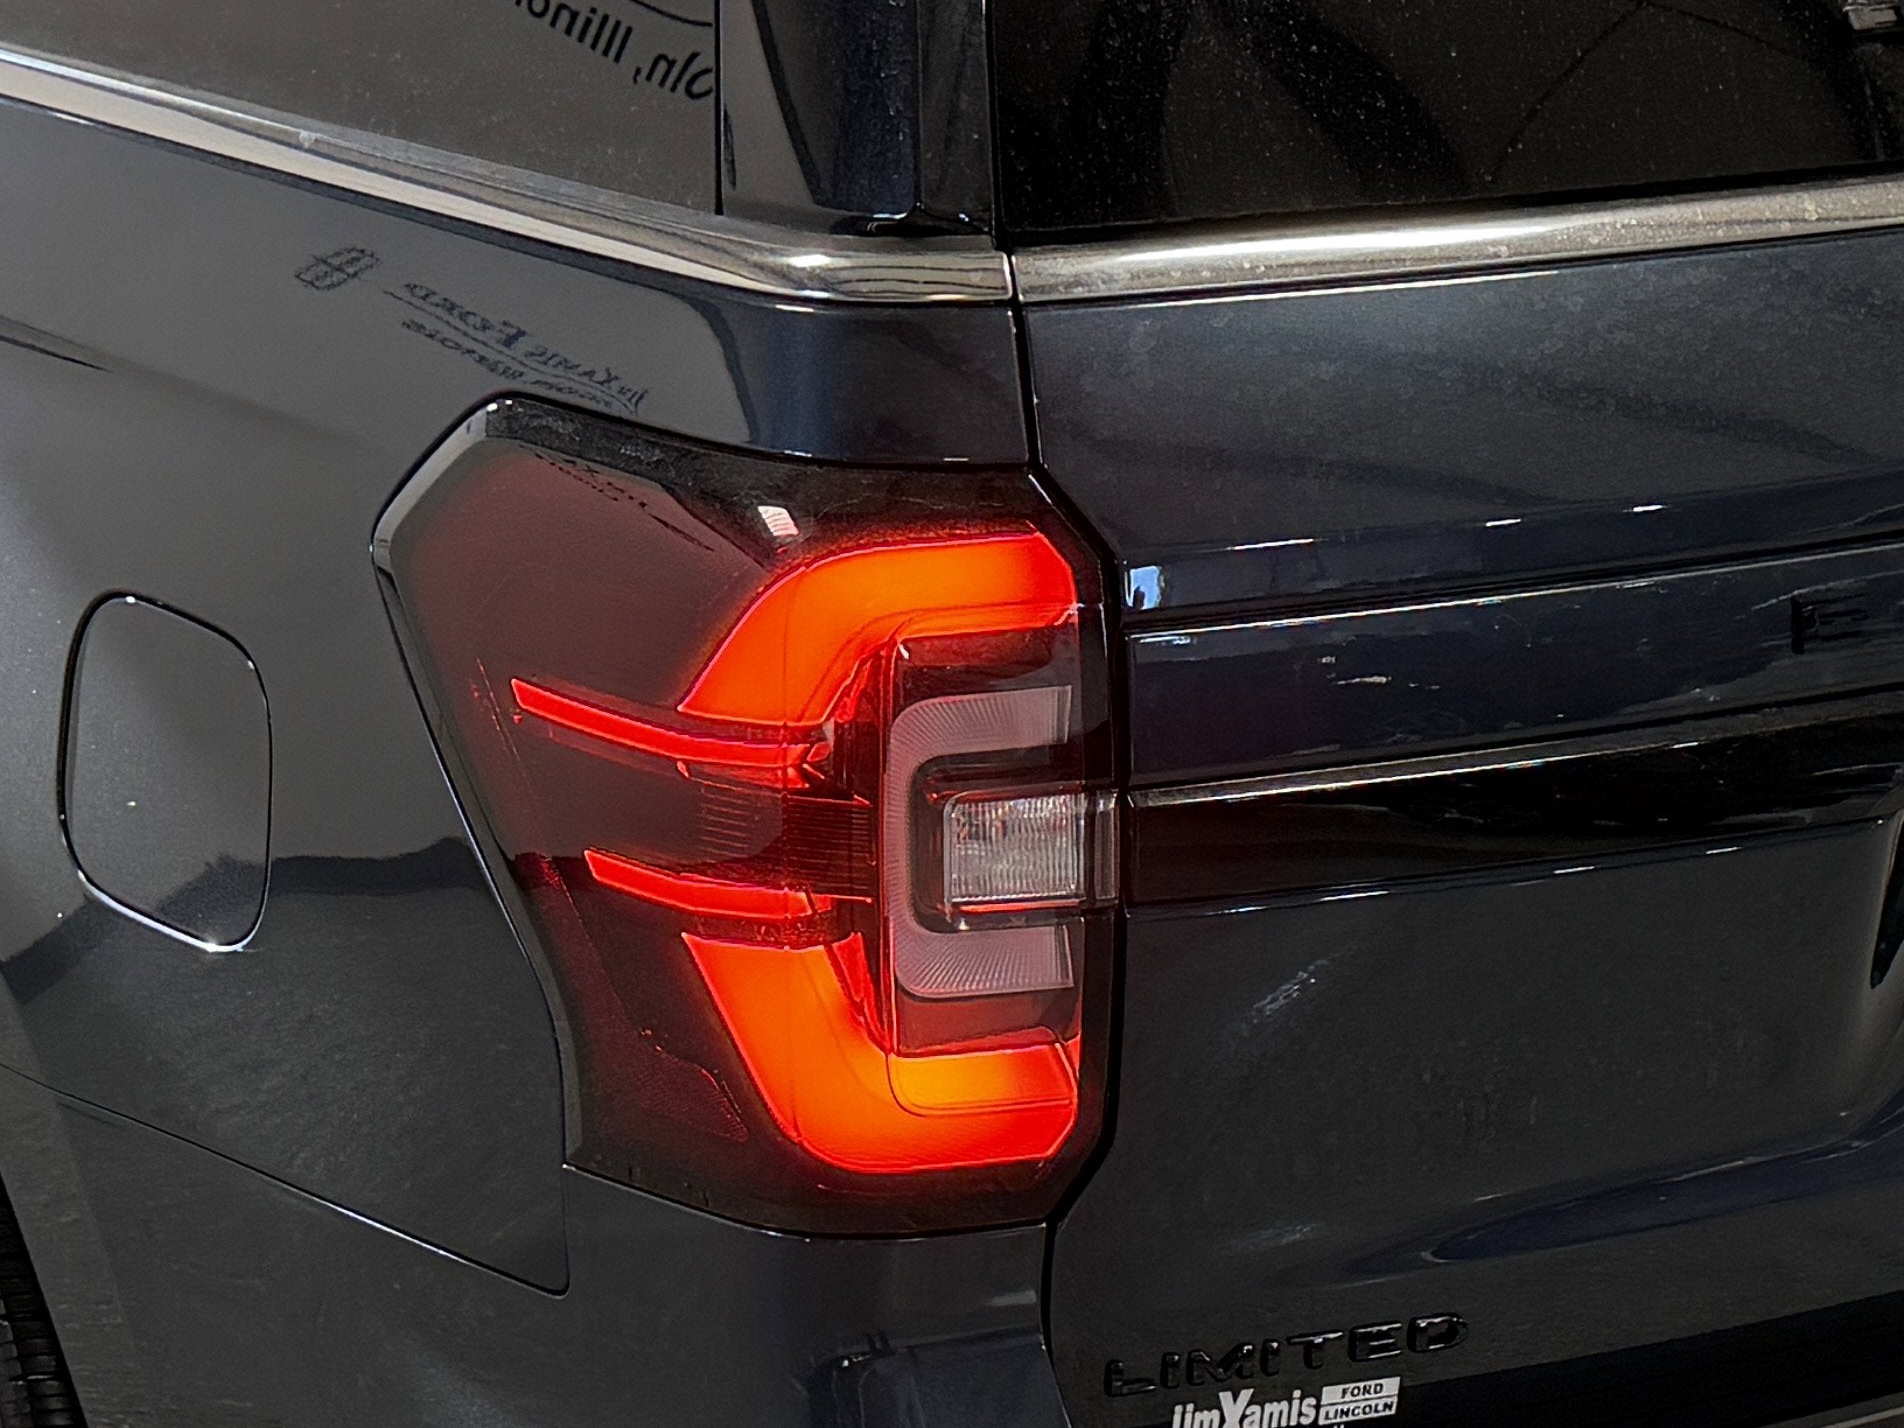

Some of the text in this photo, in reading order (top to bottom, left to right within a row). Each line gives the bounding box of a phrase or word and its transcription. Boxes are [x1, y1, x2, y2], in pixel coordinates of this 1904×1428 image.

[1102, 1311, 1470, 1399] LIMITED
[1340, 1382, 1385, 1400] FORD
[1323, 1401, 1395, 1422] LINCOLN
